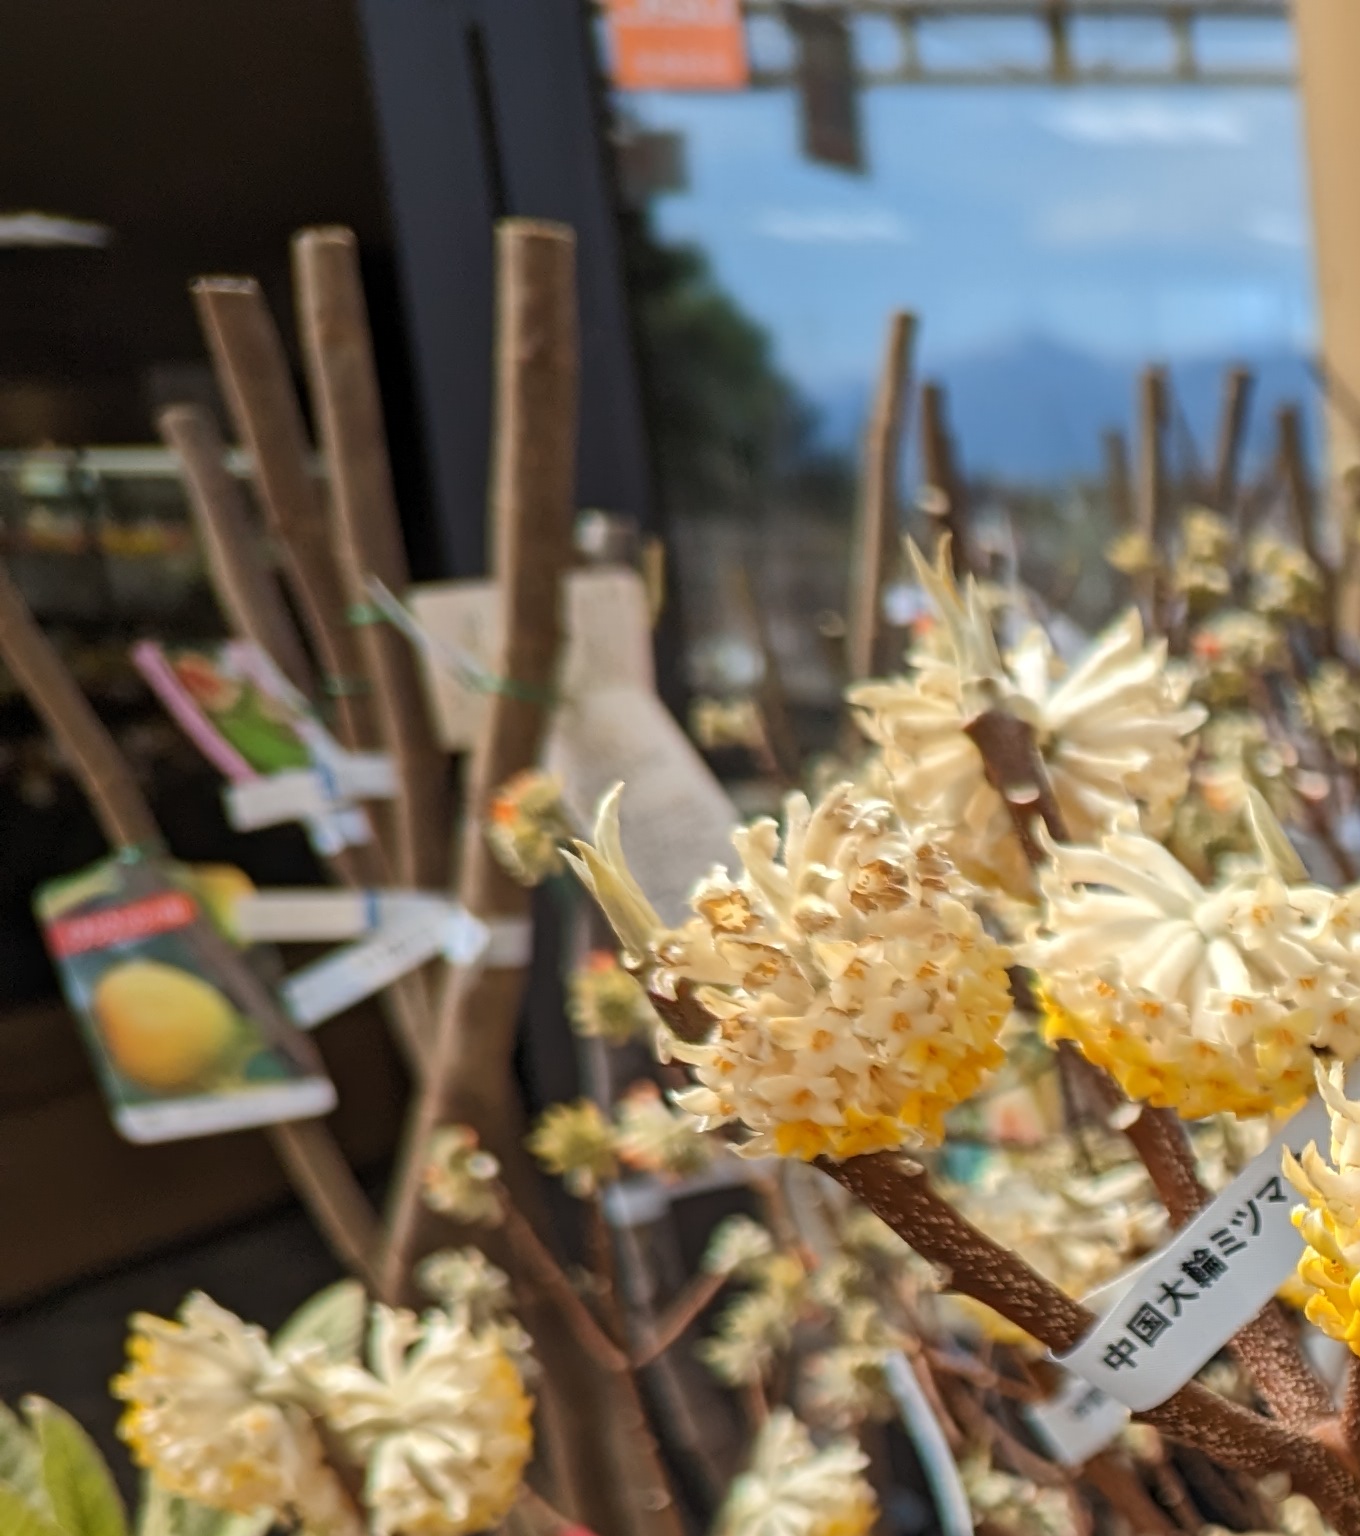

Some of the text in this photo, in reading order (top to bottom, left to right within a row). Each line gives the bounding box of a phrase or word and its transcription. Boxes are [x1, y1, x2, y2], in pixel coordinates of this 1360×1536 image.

[1103, 1152, 1301, 1371] 中国大輪ミツマ
